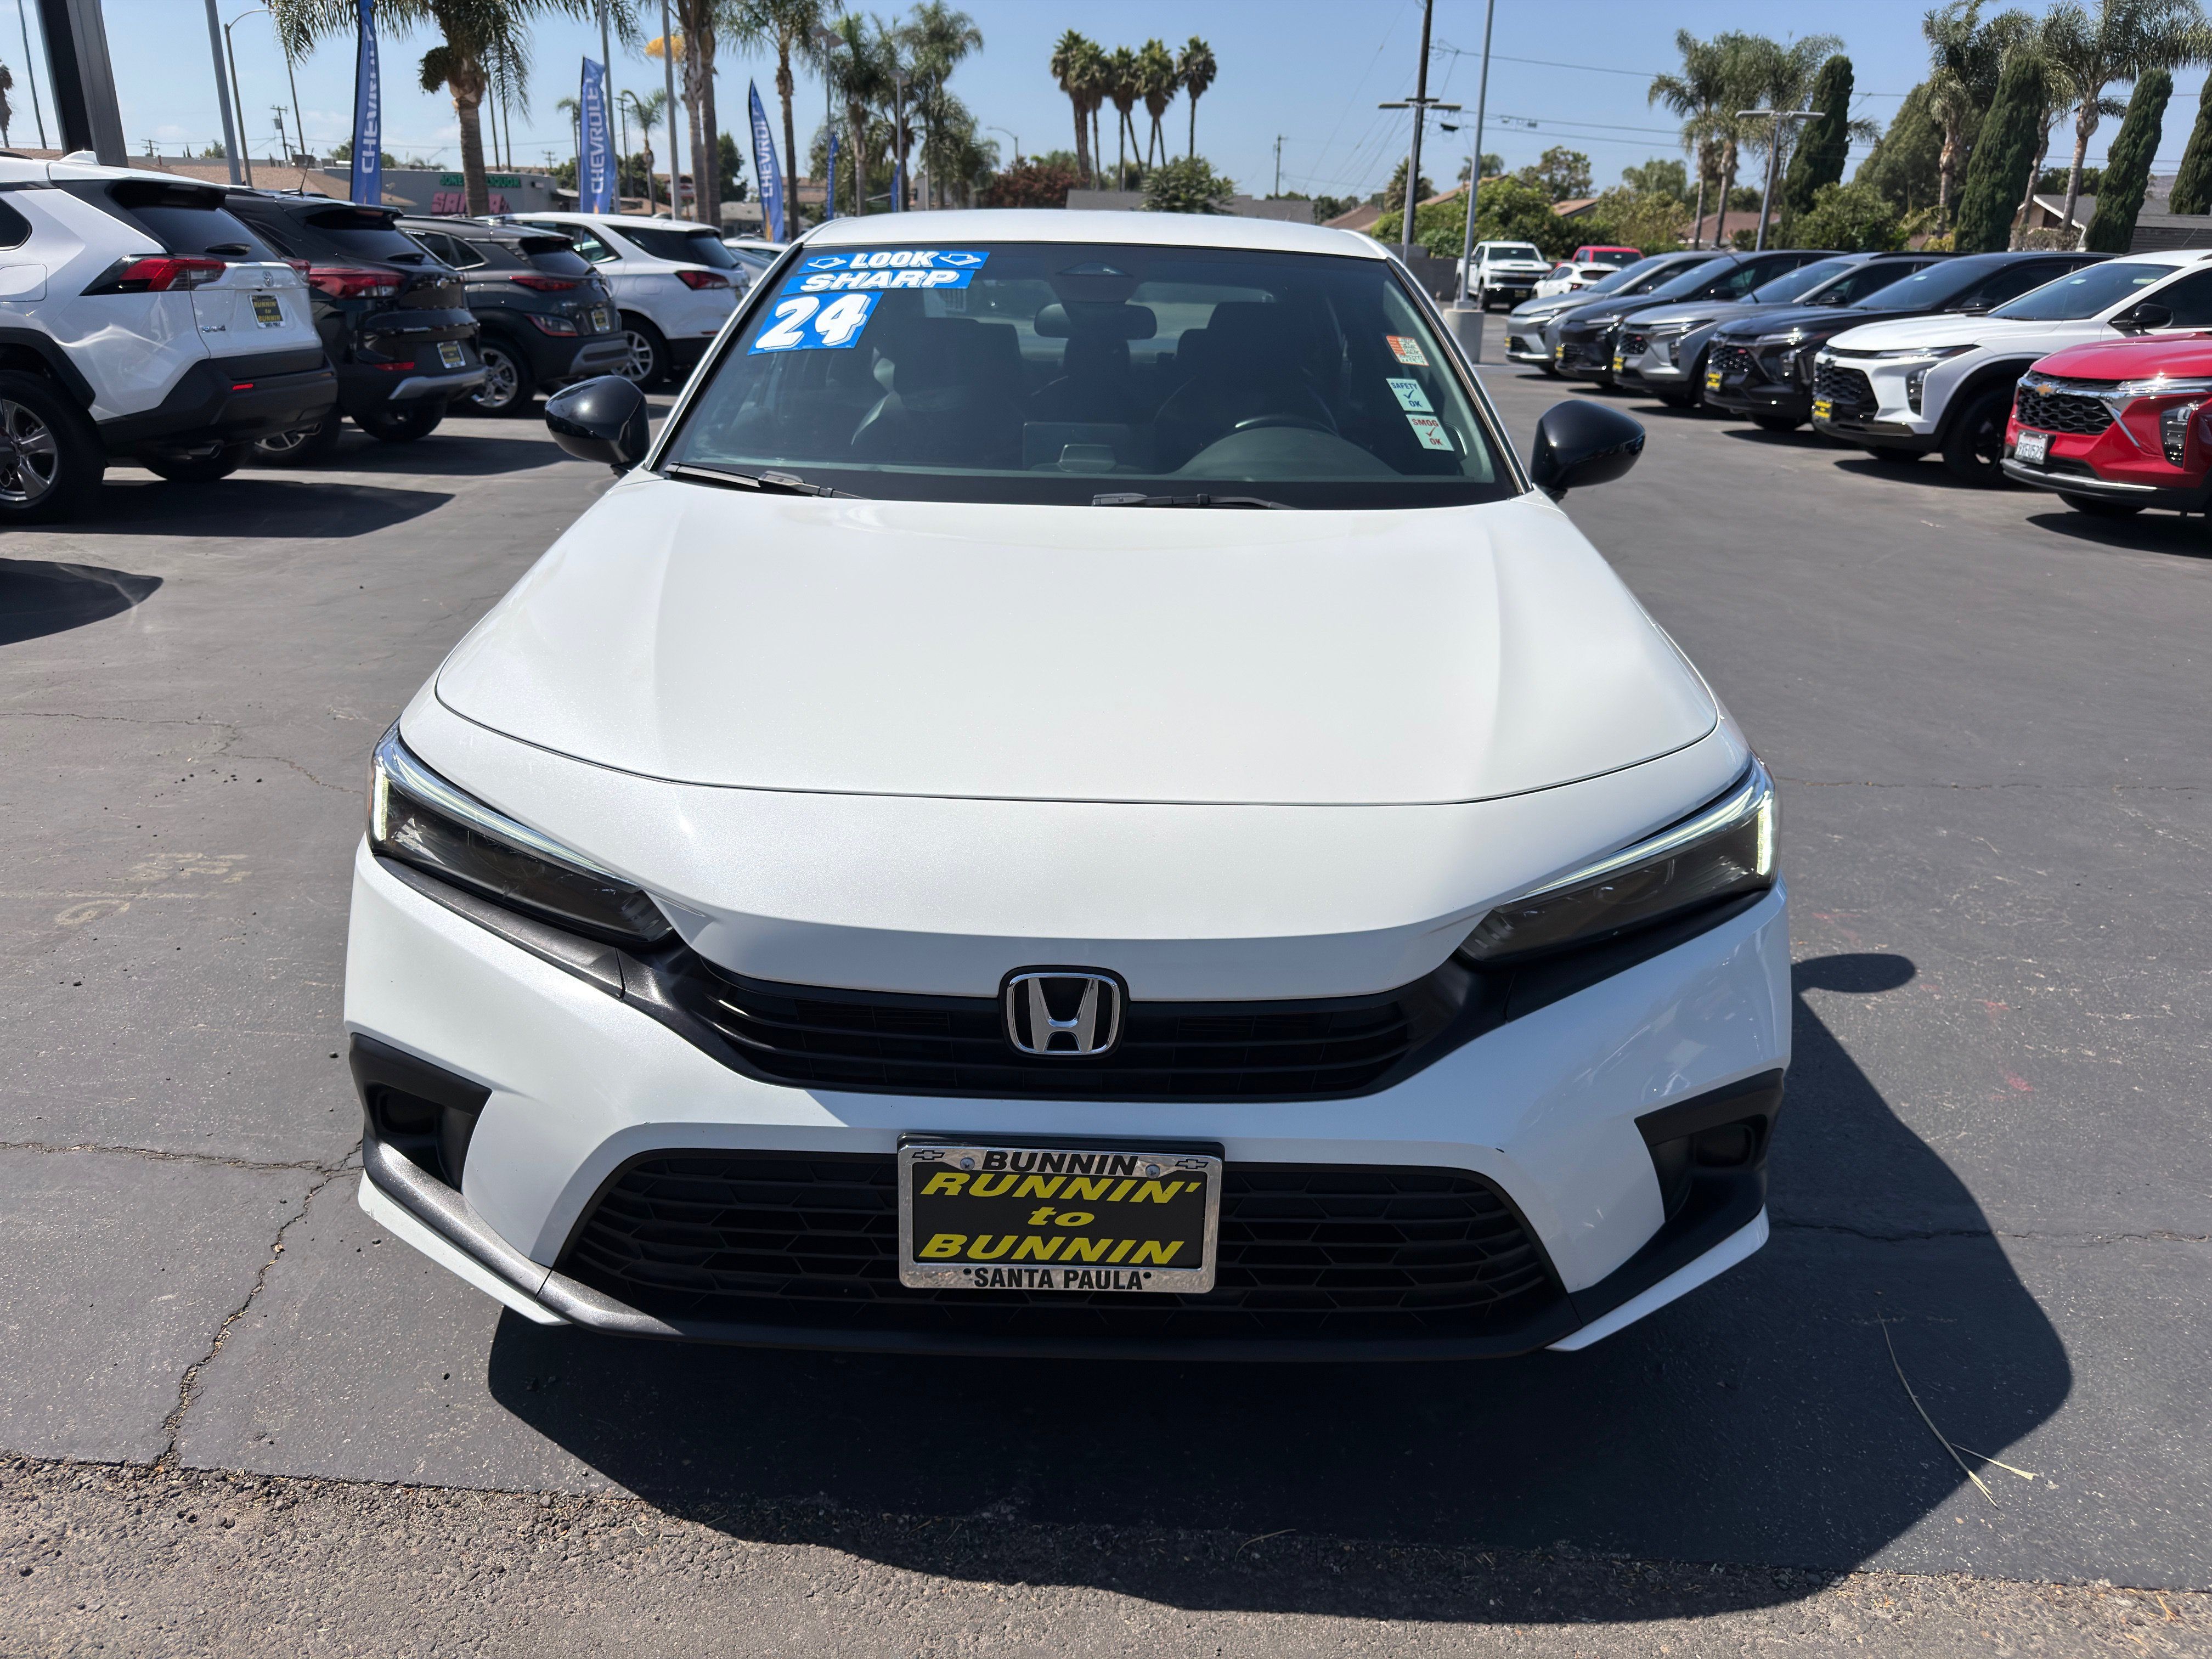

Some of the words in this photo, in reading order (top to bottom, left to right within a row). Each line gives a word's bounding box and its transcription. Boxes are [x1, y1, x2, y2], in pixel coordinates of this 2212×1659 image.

[849, 251, 939, 269] LOOK
[800, 270, 960, 292] SHARP
[755, 294, 872, 351] 24
[1412, 419, 1439, 427] SMOG
[982, 1151, 1139, 1176] BUNNIN
[920, 1172, 1201, 1204] RUNNIN'
[1028, 1207, 1095, 1227] to
[918, 1233, 1185, 1265] BUNNIN
[974, 1267, 1054, 1289] SANTA
[1063, 1269, 1143, 1291] PAULA
